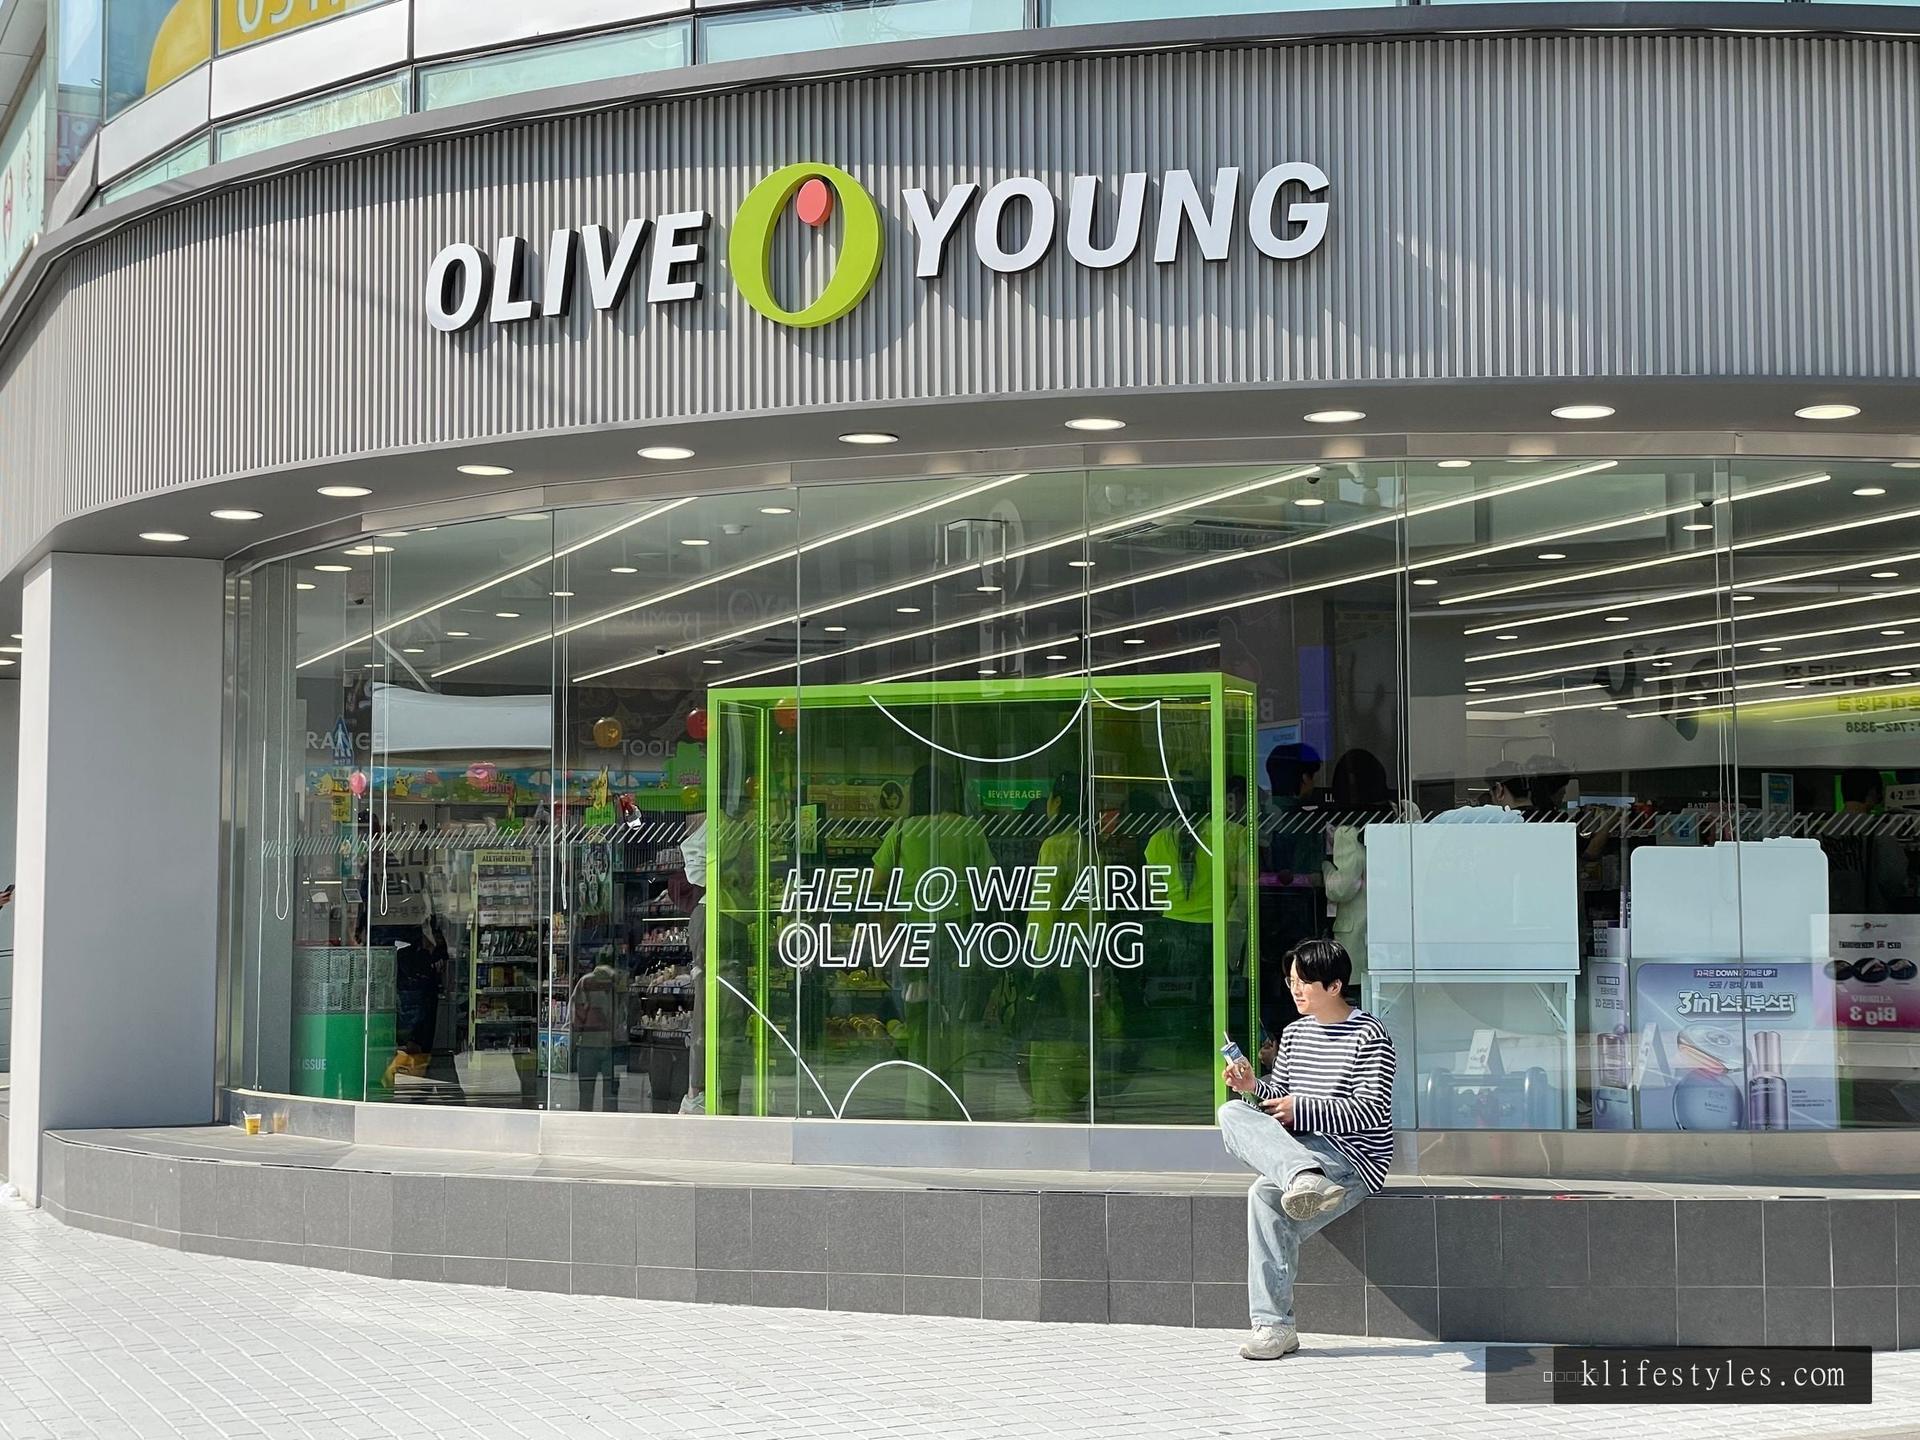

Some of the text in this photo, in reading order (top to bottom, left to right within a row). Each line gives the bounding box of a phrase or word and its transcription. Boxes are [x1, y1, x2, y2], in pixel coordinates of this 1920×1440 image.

[425, 210, 711, 333] OLIVE
[902, 161, 1330, 279] YOUNG
[780, 865, 1173, 913] HELLO WE ARE
[777, 921, 1144, 969] OLIVE YOUNG
[1715, 969, 1739, 977] DOWN
